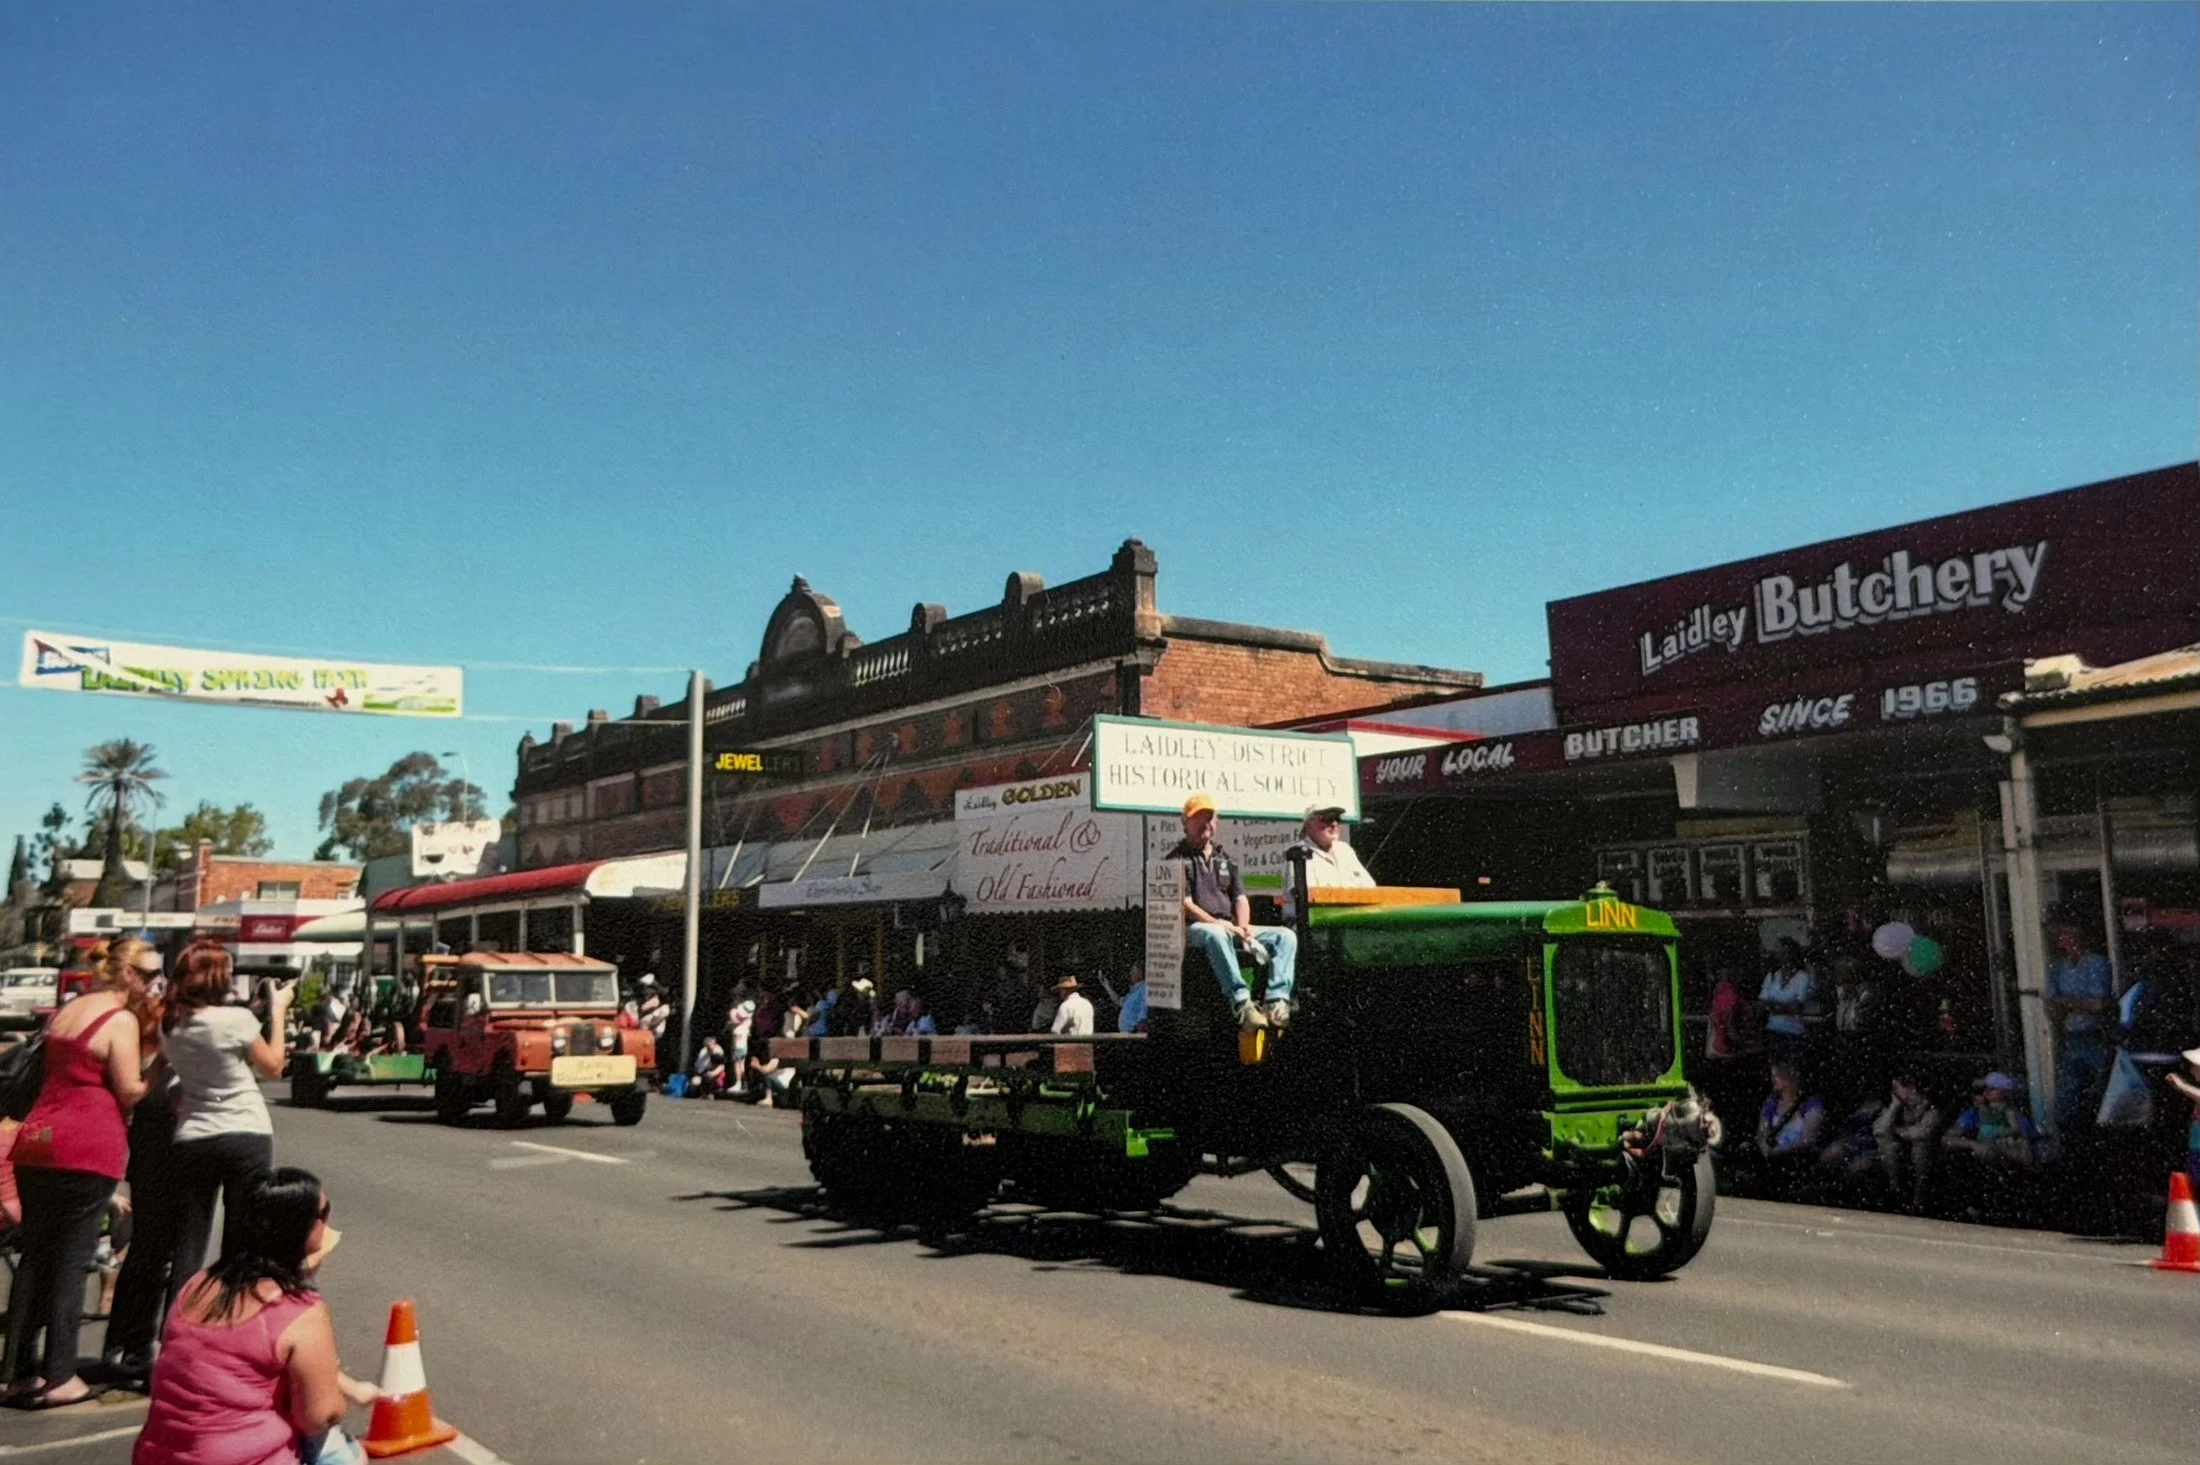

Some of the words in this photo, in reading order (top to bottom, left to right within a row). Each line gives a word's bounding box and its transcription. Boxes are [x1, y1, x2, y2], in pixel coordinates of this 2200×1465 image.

[1641, 603, 1748, 675] Laidley
[1754, 541, 2048, 643] Butchery
[1124, 733, 1221, 760] LAIDLEY
[1232, 741, 1327, 768] DISTRICT
[1376, 755, 1427, 784] YOUR
[1441, 742, 1515, 776] LOCAL
[1564, 717, 1699, 760] BUTCHER
[1758, 694, 1853, 735] SINCE
[1880, 677, 1978, 720] 1966
[1002, 779, 1082, 805] GOLDEN
[1109, 764, 1244, 792] HISTORICAL
[1253, 774, 1340, 797] SOCIETY
[970, 810, 1074, 856] Traditional
[976, 862, 1022, 901] Old
[1017, 857, 1109, 901] Fashioned
[1586, 901, 1637, 928] LINN
[1527, 955, 1545, 1065] LINN
